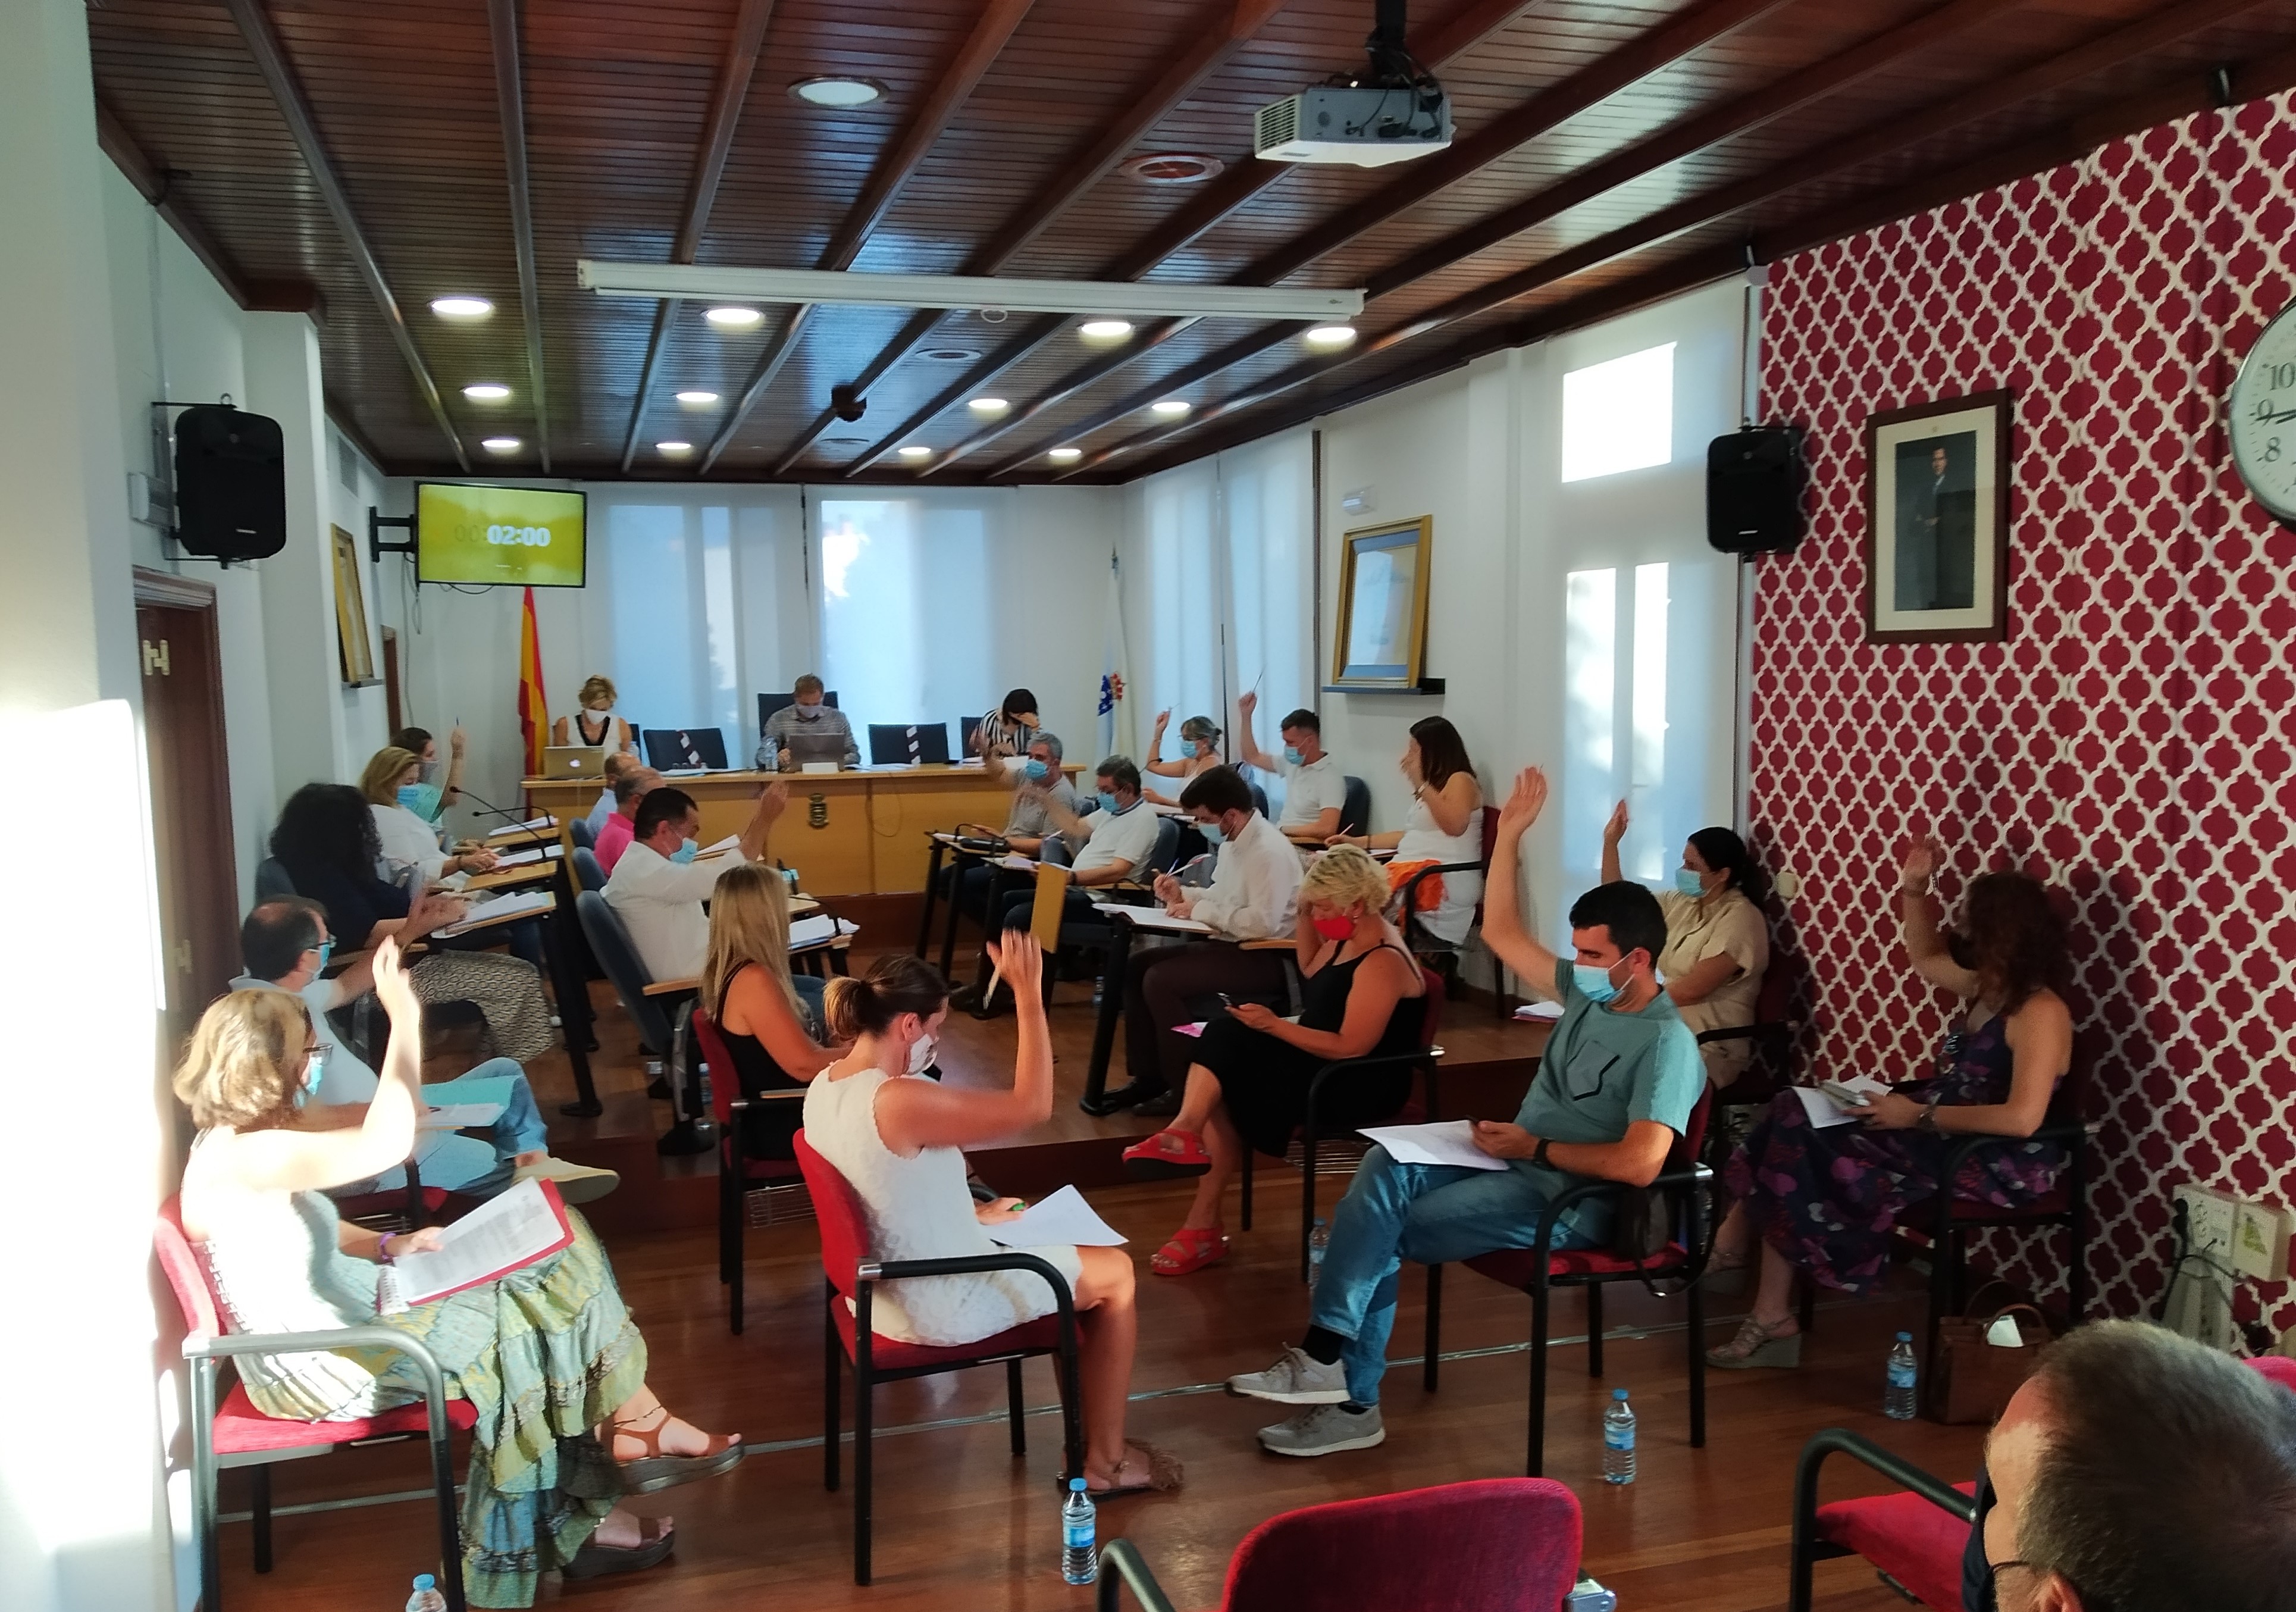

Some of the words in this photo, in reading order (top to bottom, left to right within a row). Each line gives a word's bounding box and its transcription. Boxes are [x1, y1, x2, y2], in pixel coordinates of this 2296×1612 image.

[2268, 361, 2295, 391] 10
[2257, 398, 2274, 427] 9
[2264, 436, 2281, 462] 8
[487, 524, 551, 547] 02:00
